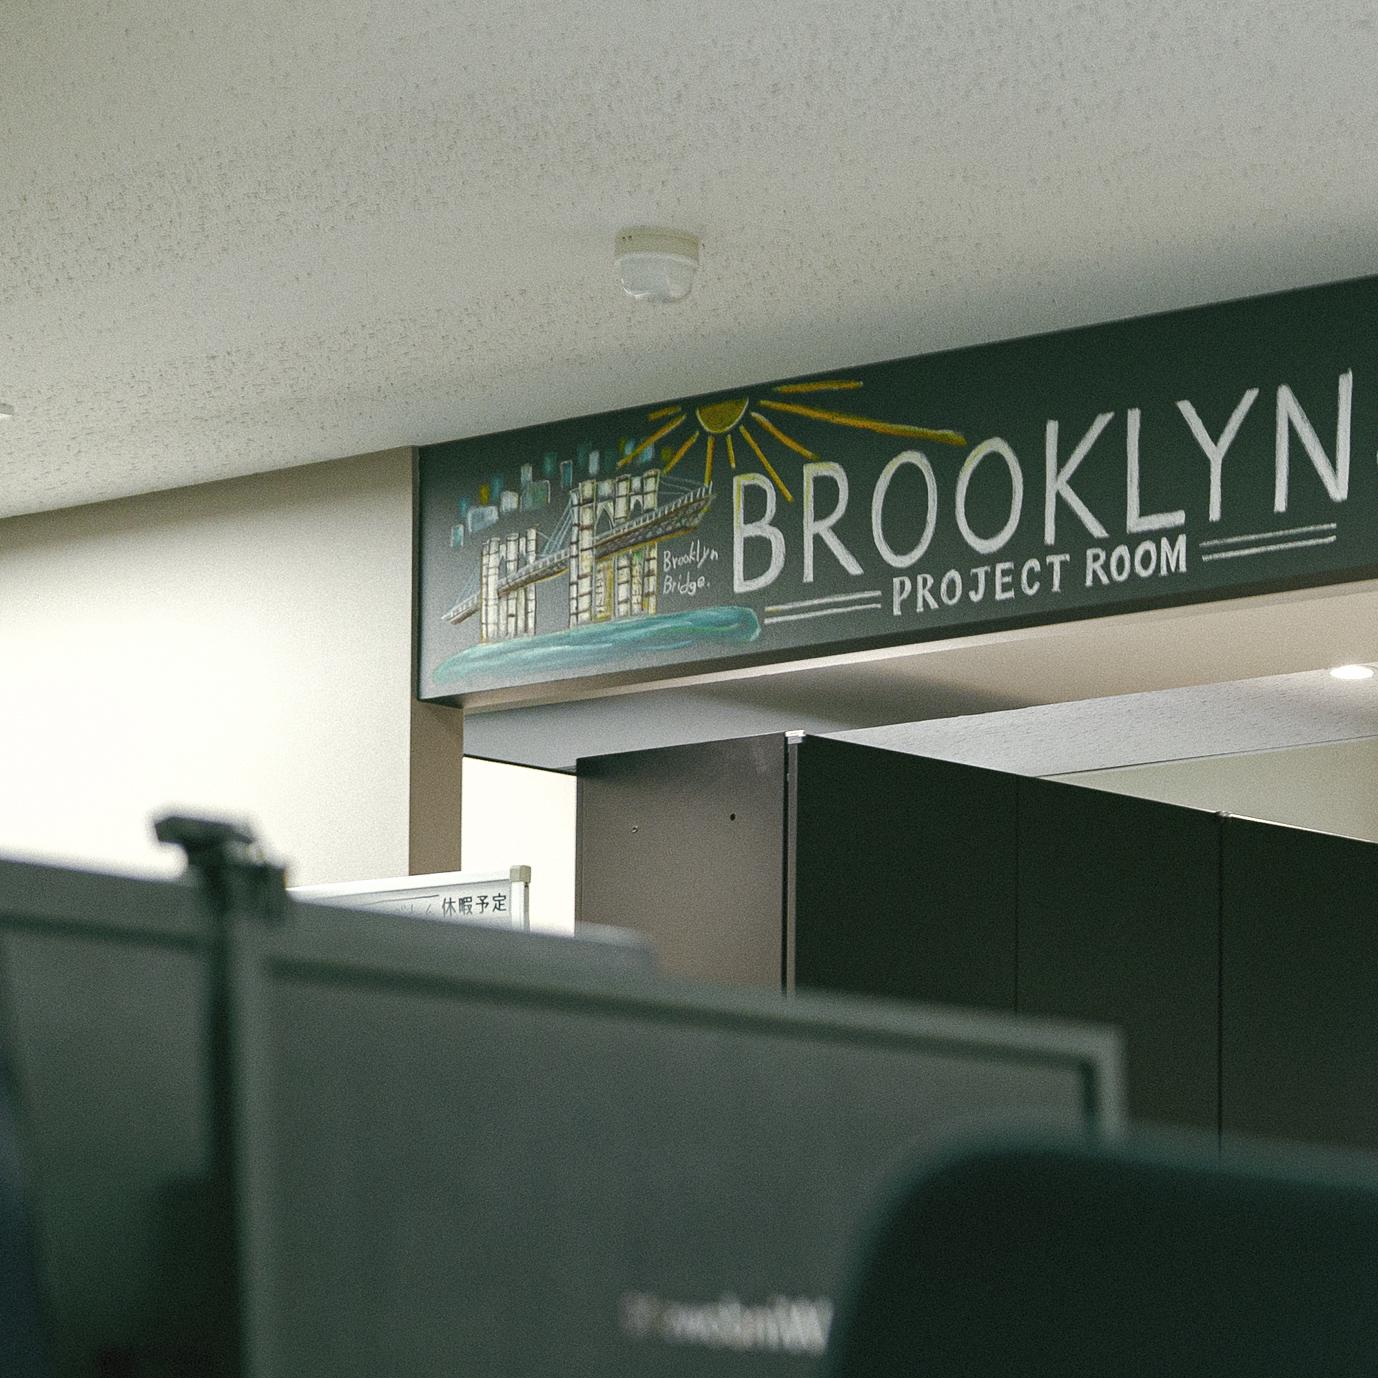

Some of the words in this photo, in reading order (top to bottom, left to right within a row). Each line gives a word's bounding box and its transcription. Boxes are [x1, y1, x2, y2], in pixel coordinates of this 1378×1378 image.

[732, 368, 1352, 594] BROOKLYN
[663, 539, 719, 572] Brooklyn
[892, 553, 1070, 616] PROJECT
[1085, 533, 1187, 587] ROOM
[442, 893, 507, 918] 休暇予定
